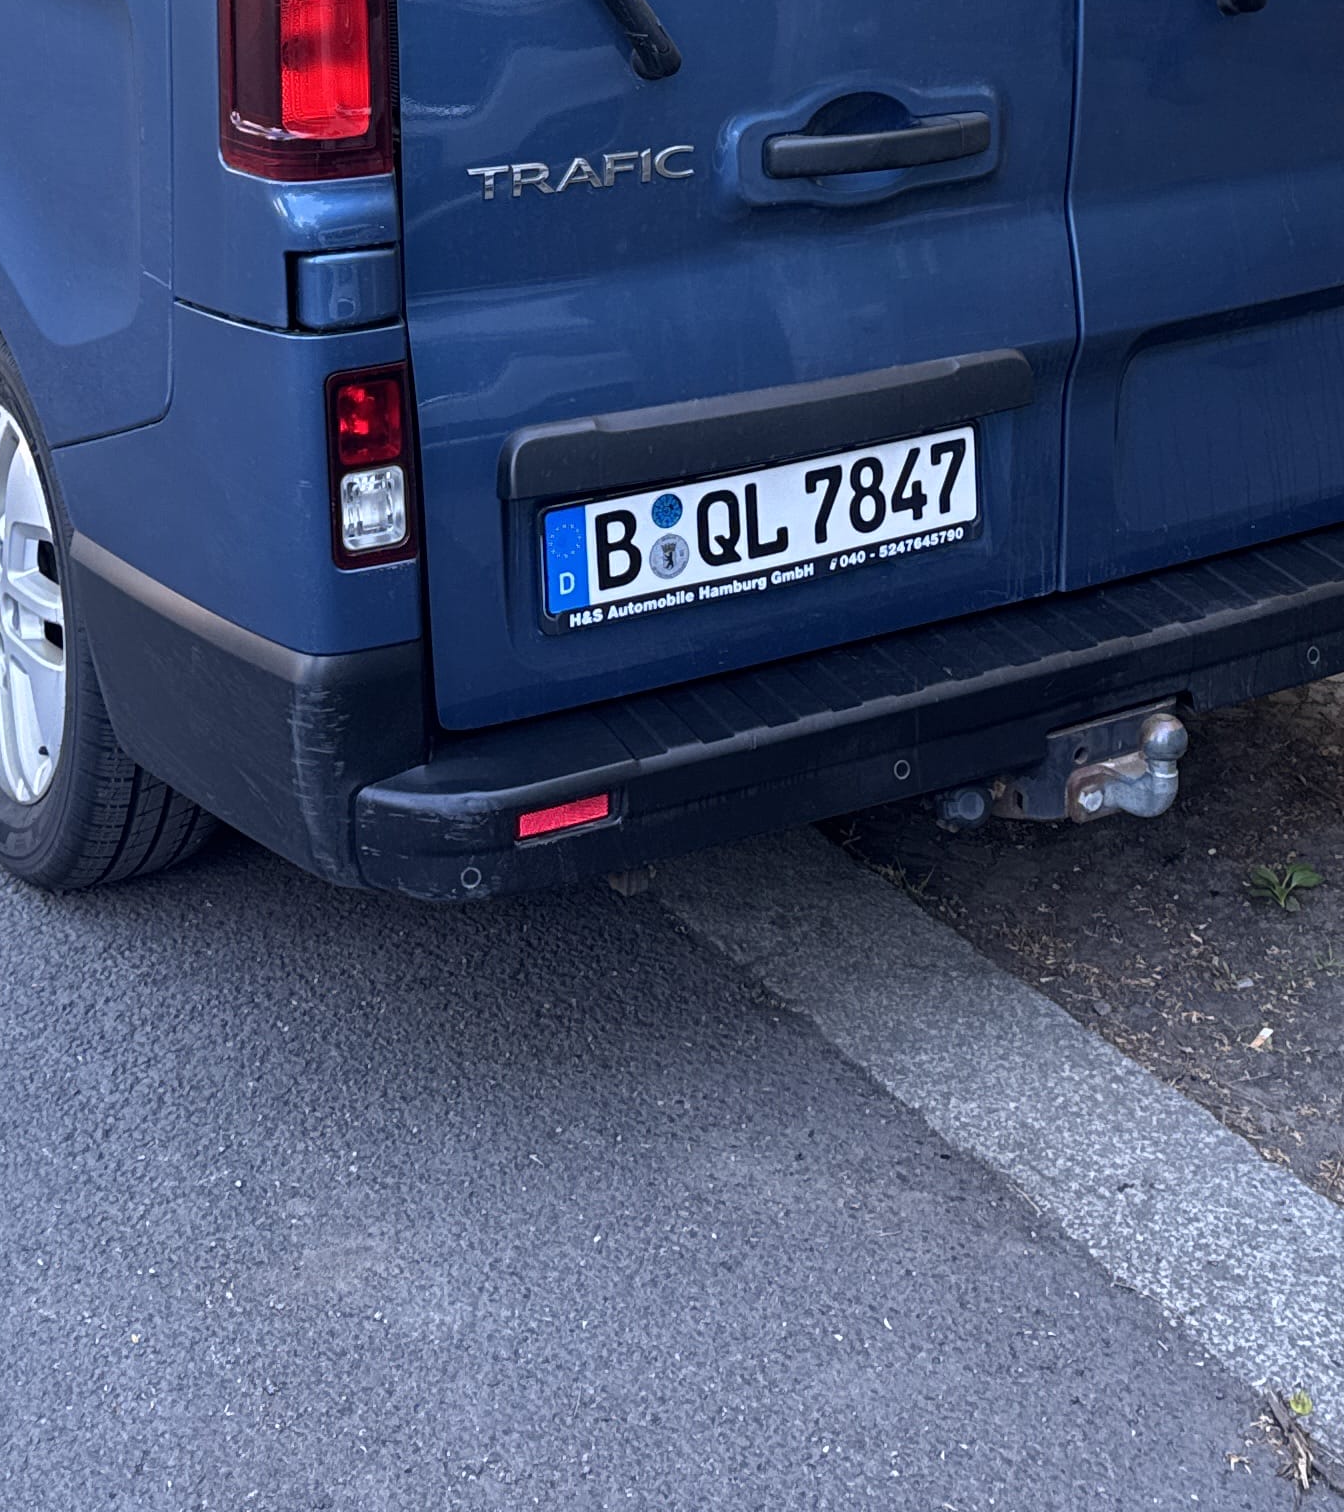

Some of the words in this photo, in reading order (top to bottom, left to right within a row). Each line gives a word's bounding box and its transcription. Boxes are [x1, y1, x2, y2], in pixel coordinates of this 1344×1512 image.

[467, 144, 695, 200] TRAFIC
[595, 509, 642, 591] B
[697, 483, 788, 566] QL
[805, 438, 966, 544] 7847
[559, 571, 575, 596] D
[569, 608, 604, 628] H&S
[607, 590, 695, 620] Automobile
[699, 576, 767, 600] Hamburg
[771, 563, 814, 584] GmbH
[839, 551, 866, 568] 040
[878, 527, 964, 559] 5247645790
